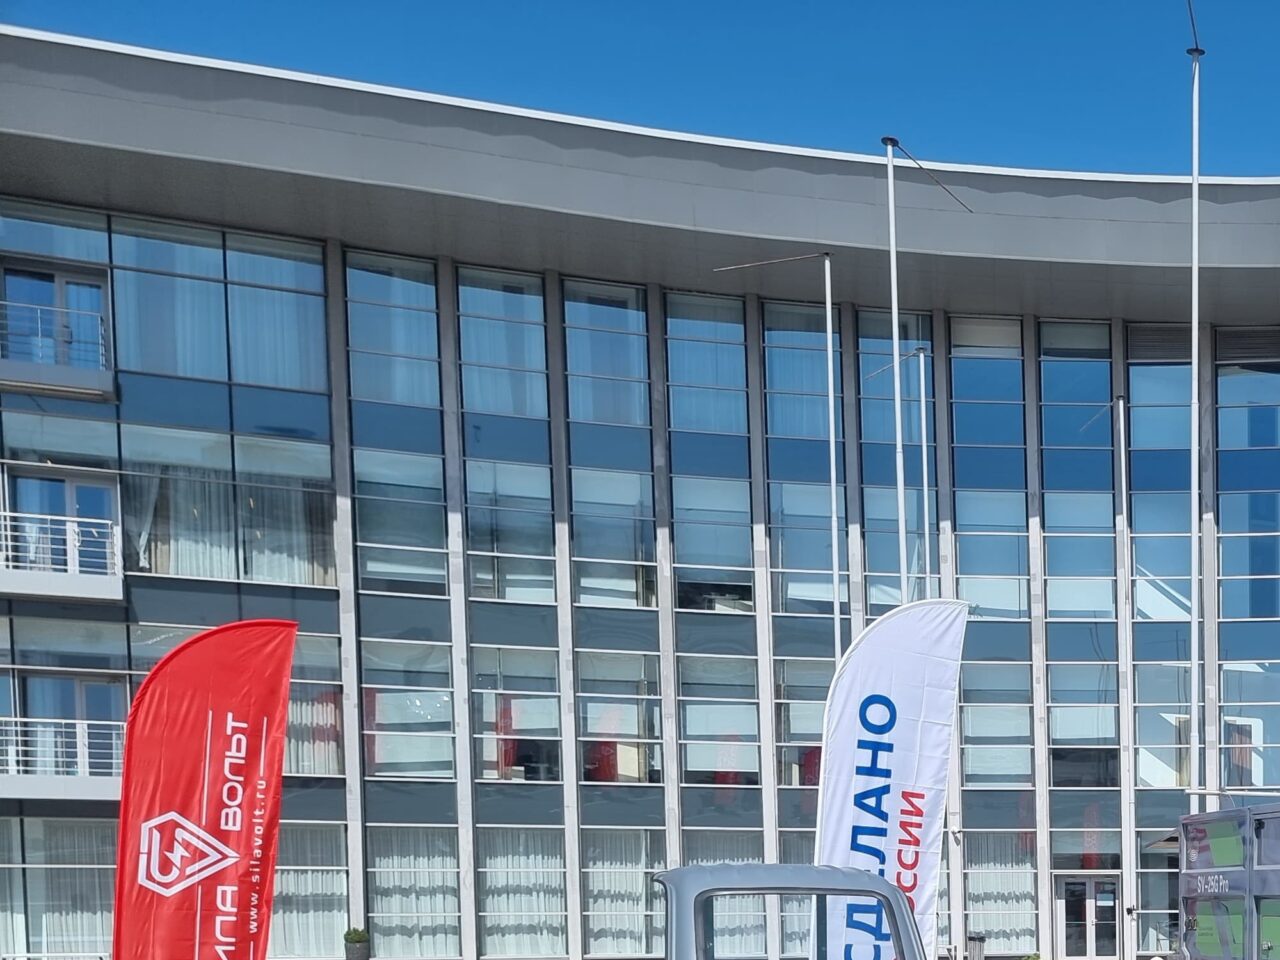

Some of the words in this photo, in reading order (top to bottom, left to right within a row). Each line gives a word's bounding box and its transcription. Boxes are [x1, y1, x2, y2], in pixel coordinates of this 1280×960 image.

[219, 711, 249, 832] ВОЛЬТ
[249, 780, 267, 935] www.silavolt.ru
[896, 790, 926, 914] ССИИ
[1197, 875, 1219, 893] SV-25G
[1219, 875, 1229, 893] Pro
